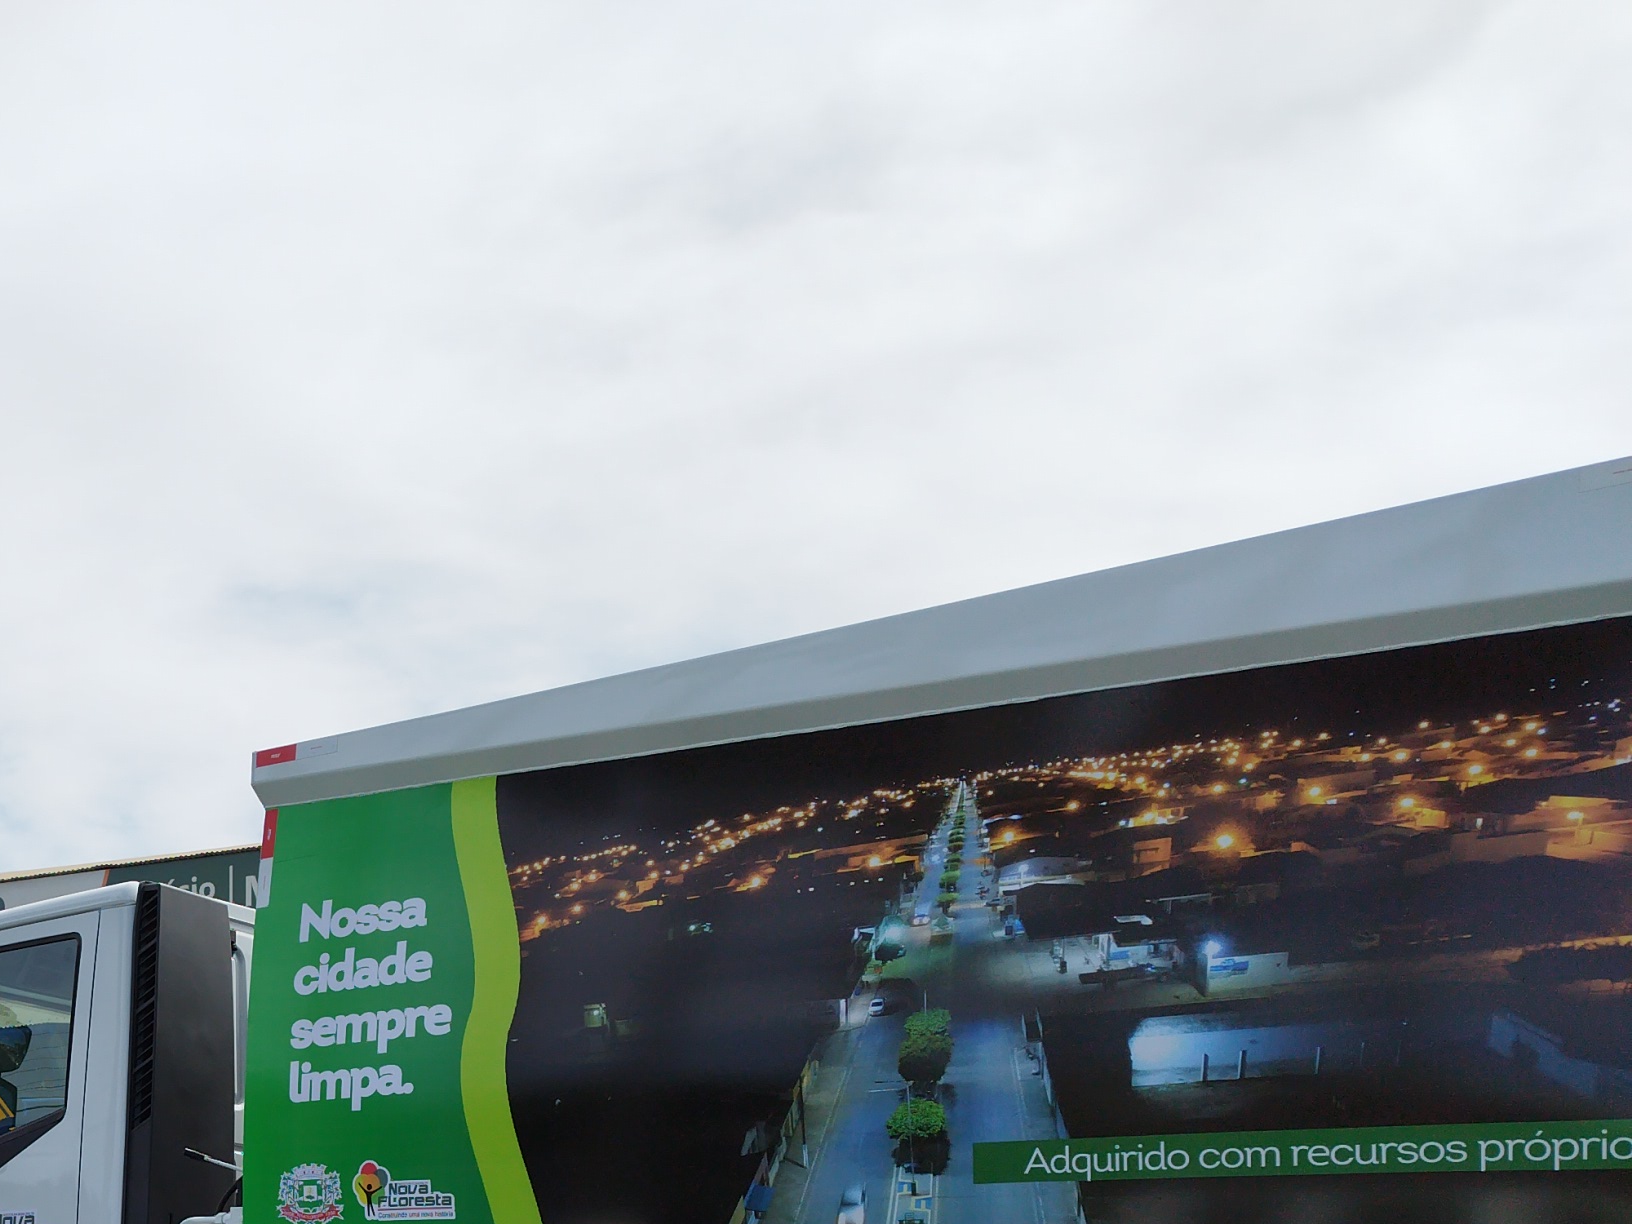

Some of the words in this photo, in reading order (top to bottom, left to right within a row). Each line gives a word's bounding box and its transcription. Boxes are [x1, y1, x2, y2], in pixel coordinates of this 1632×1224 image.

[299, 897, 428, 943] Nossa
[293, 940, 433, 996] cidade
[289, 1004, 453, 1055] sempre
[289, 1060, 414, 1112] limpa.
[1024, 1140, 1190, 1182] Adquirido
[1198, 1144, 1281, 1170] com
[1289, 1139, 1469, 1167] recursos
[388, 1182, 429, 1196] Nova
